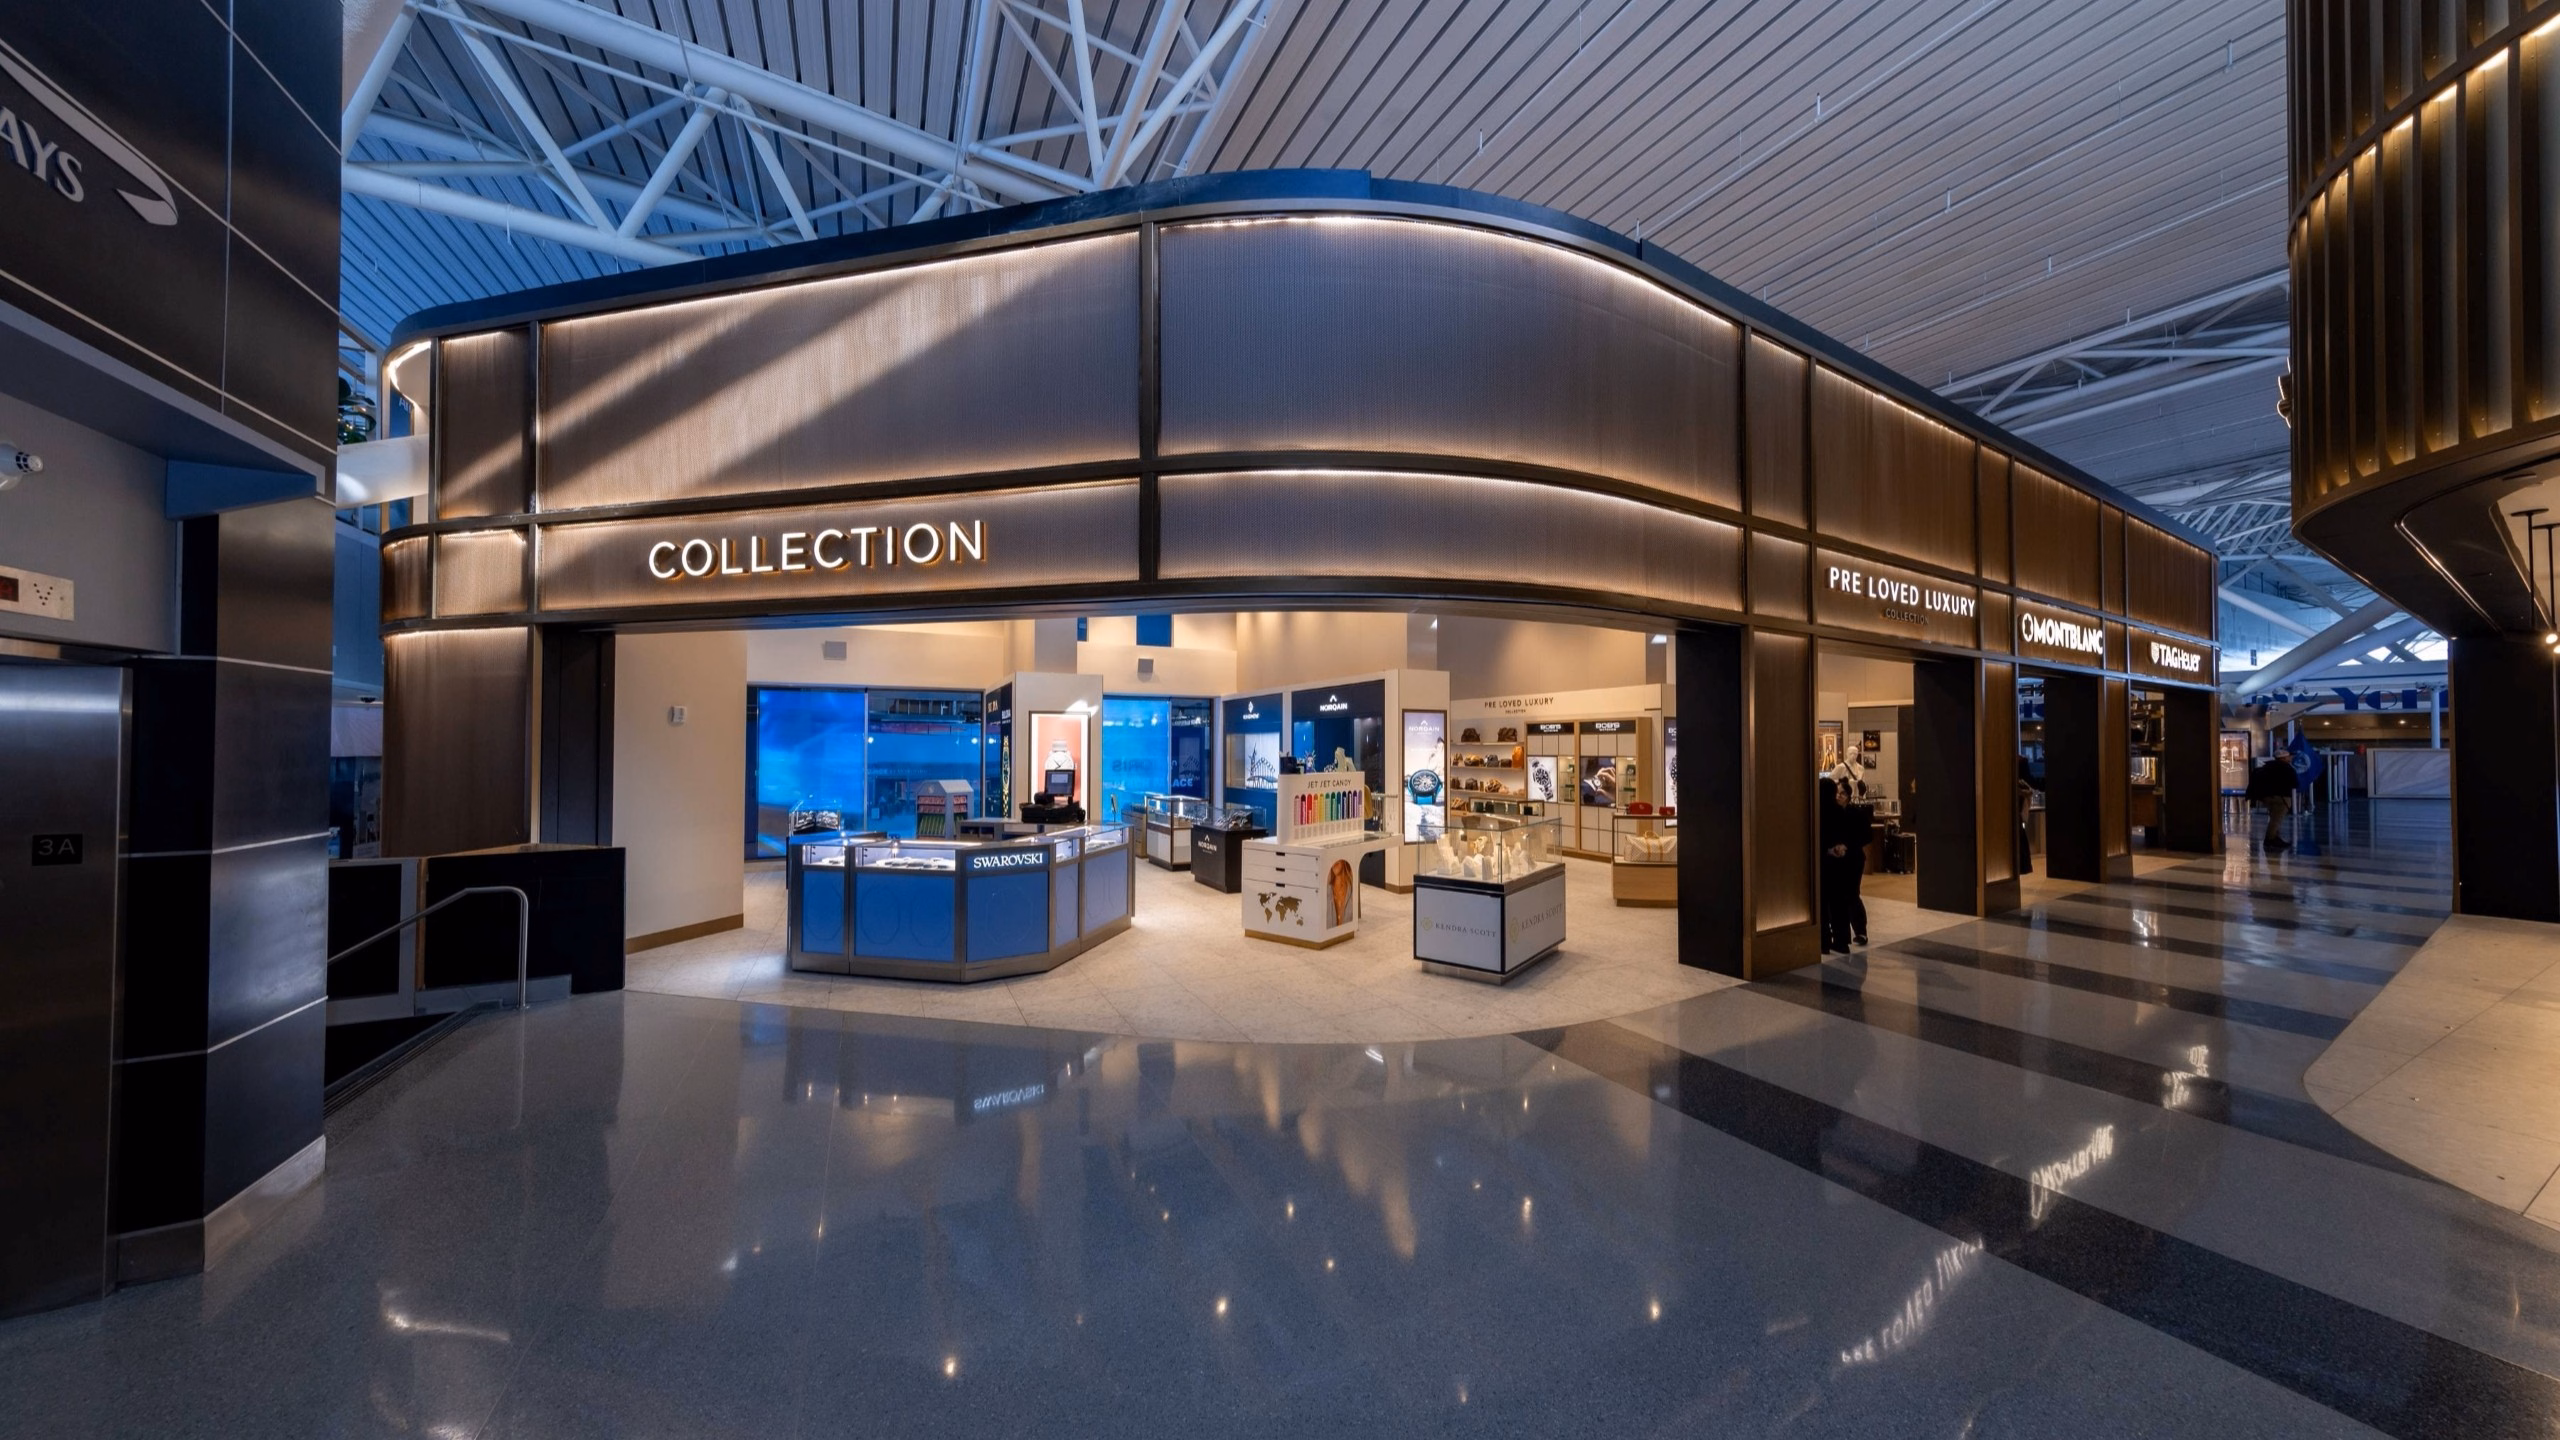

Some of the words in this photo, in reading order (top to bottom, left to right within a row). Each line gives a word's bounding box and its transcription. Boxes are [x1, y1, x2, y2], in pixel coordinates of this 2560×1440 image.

[648, 519, 985, 579] COLLECTION
[1829, 566, 1862, 594] PRE
[1867, 576, 1920, 606] LOVED
[1924, 588, 1976, 618] LUXURY
[1884, 608, 1930, 626] COLLECTION
[2033, 615, 2104, 656] MONTBLANC
[1319, 702, 1348, 712] NORQAIN
[1484, 701, 1497, 709] PRE
[1498, 699, 1523, 709] LOVED
[1524, 697, 1555, 707] LUXURY
[1307, 781, 1319, 789] JET
[38, 838, 76, 856] 3A
[973, 852, 1044, 869] SWAROVSKI
[1521, 911, 1545, 931] KENDRA
[1545, 903, 1563, 919] SCOTT
[1435, 921, 1468, 934] KENDRA
[1470, 927, 1497, 938] SCOTT
